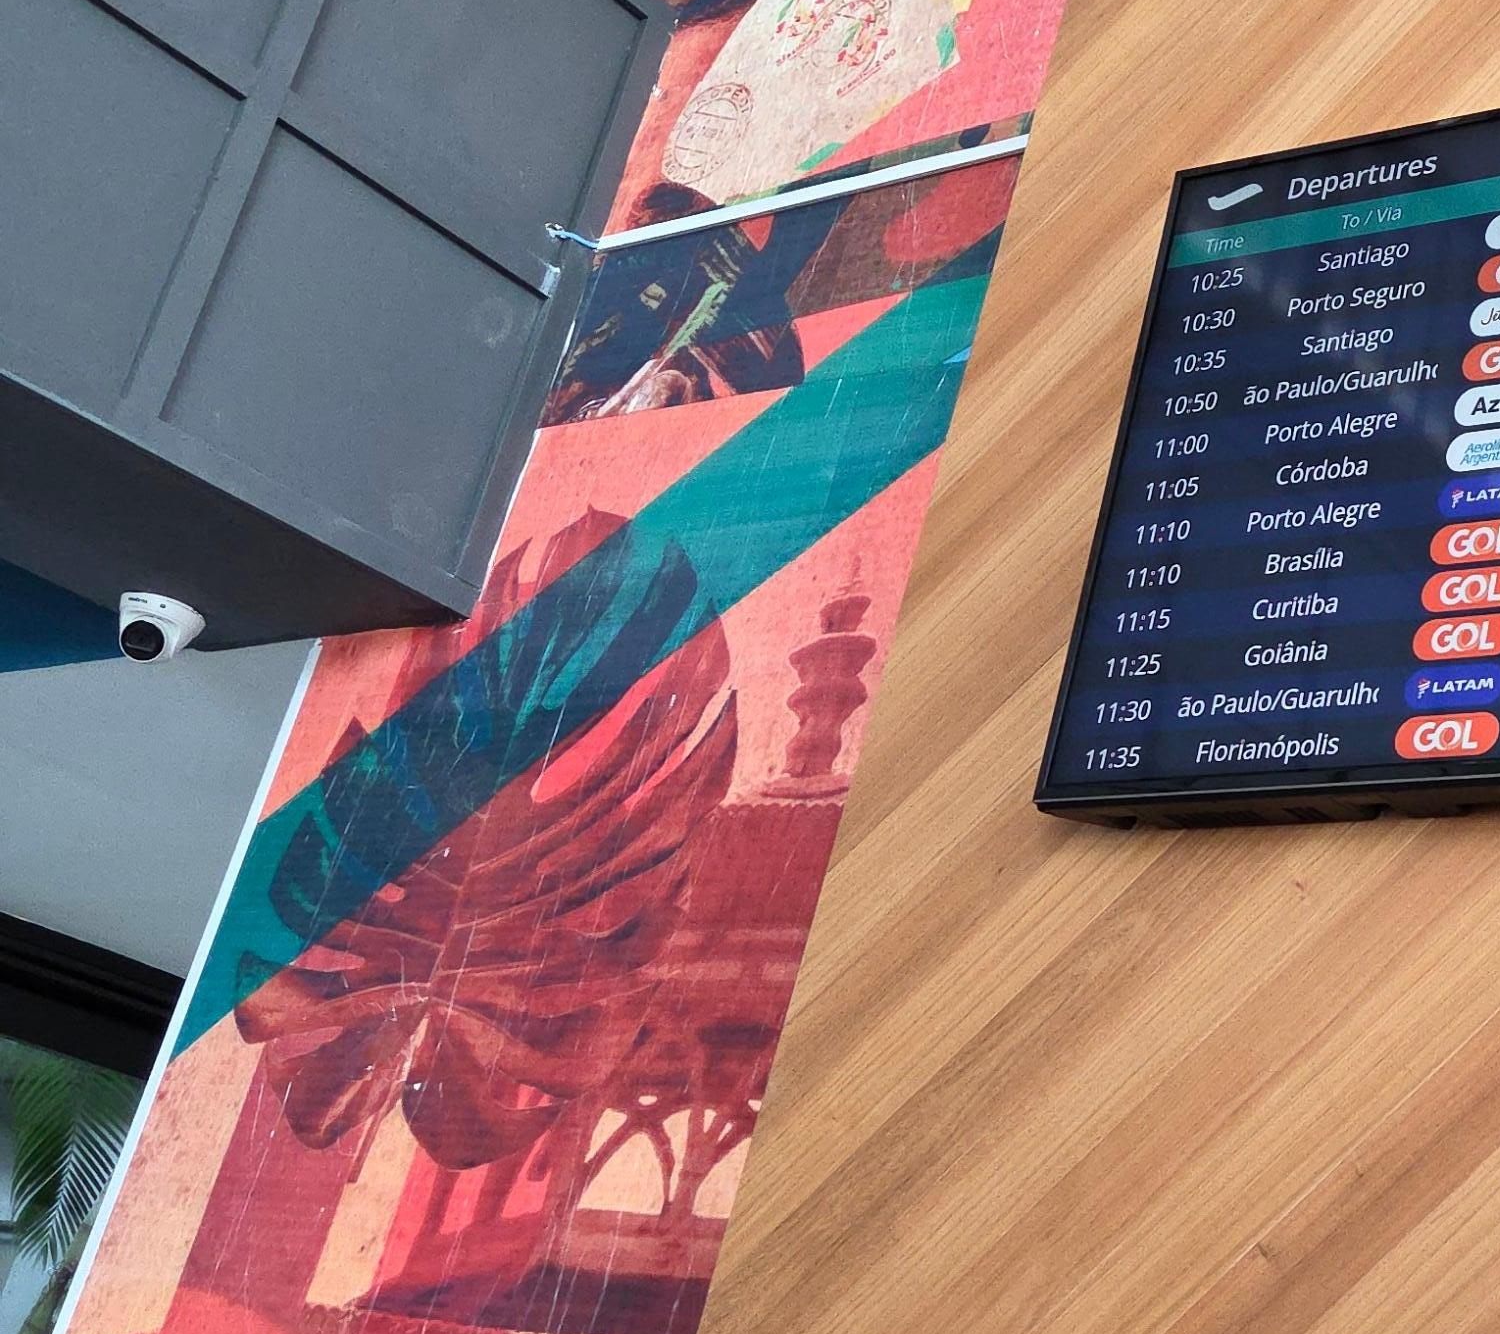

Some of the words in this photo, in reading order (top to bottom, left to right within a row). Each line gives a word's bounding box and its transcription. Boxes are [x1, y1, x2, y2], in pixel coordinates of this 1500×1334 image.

[1287, 156, 1438, 200] Departures
[1205, 236, 1244, 254] Time
[1341, 213, 1361, 230] To
[1363, 210, 1374, 226] /
[1377, 206, 1402, 223] Via
[1192, 267, 1244, 293] 10:25
[1317, 243, 1410, 272] Santiago
[1182, 308, 1236, 334] 10:30
[1287, 293, 1345, 318] Porto
[1349, 281, 1425, 309] Seguro
[1174, 349, 1227, 375] 10:35
[1300, 328, 1394, 356] Santiago
[1165, 391, 1218, 417] 10:50
[1156, 433, 1209, 459] 11:00
[1265, 420, 1323, 445] Porto
[1327, 412, 1398, 438] Alegre
[1146, 476, 1200, 501] 11:05
[1276, 455, 1368, 486] Córdoba
[1137, 519, 1191, 545] 11:10
[1246, 509, 1306, 533] Porto
[1309, 502, 1381, 528] Alegre
[1127, 563, 1181, 589] 11:10
[1264, 547, 1344, 575] Brasília
[1117, 608, 1171, 633] 11:15
[1252, 592, 1339, 620] Curitiba
[1107, 653, 1162, 678] 11:25
[1244, 640, 1328, 667] Goiânia
[1430, 620, 1495, 654] GOL
[1097, 699, 1152, 724] 11:30
[1432, 677, 1494, 693] LATAM
[1086, 746, 1142, 770] 11:35
[1195, 732, 1340, 765] Florianópolis
[1413, 719, 1478, 752] GOL
